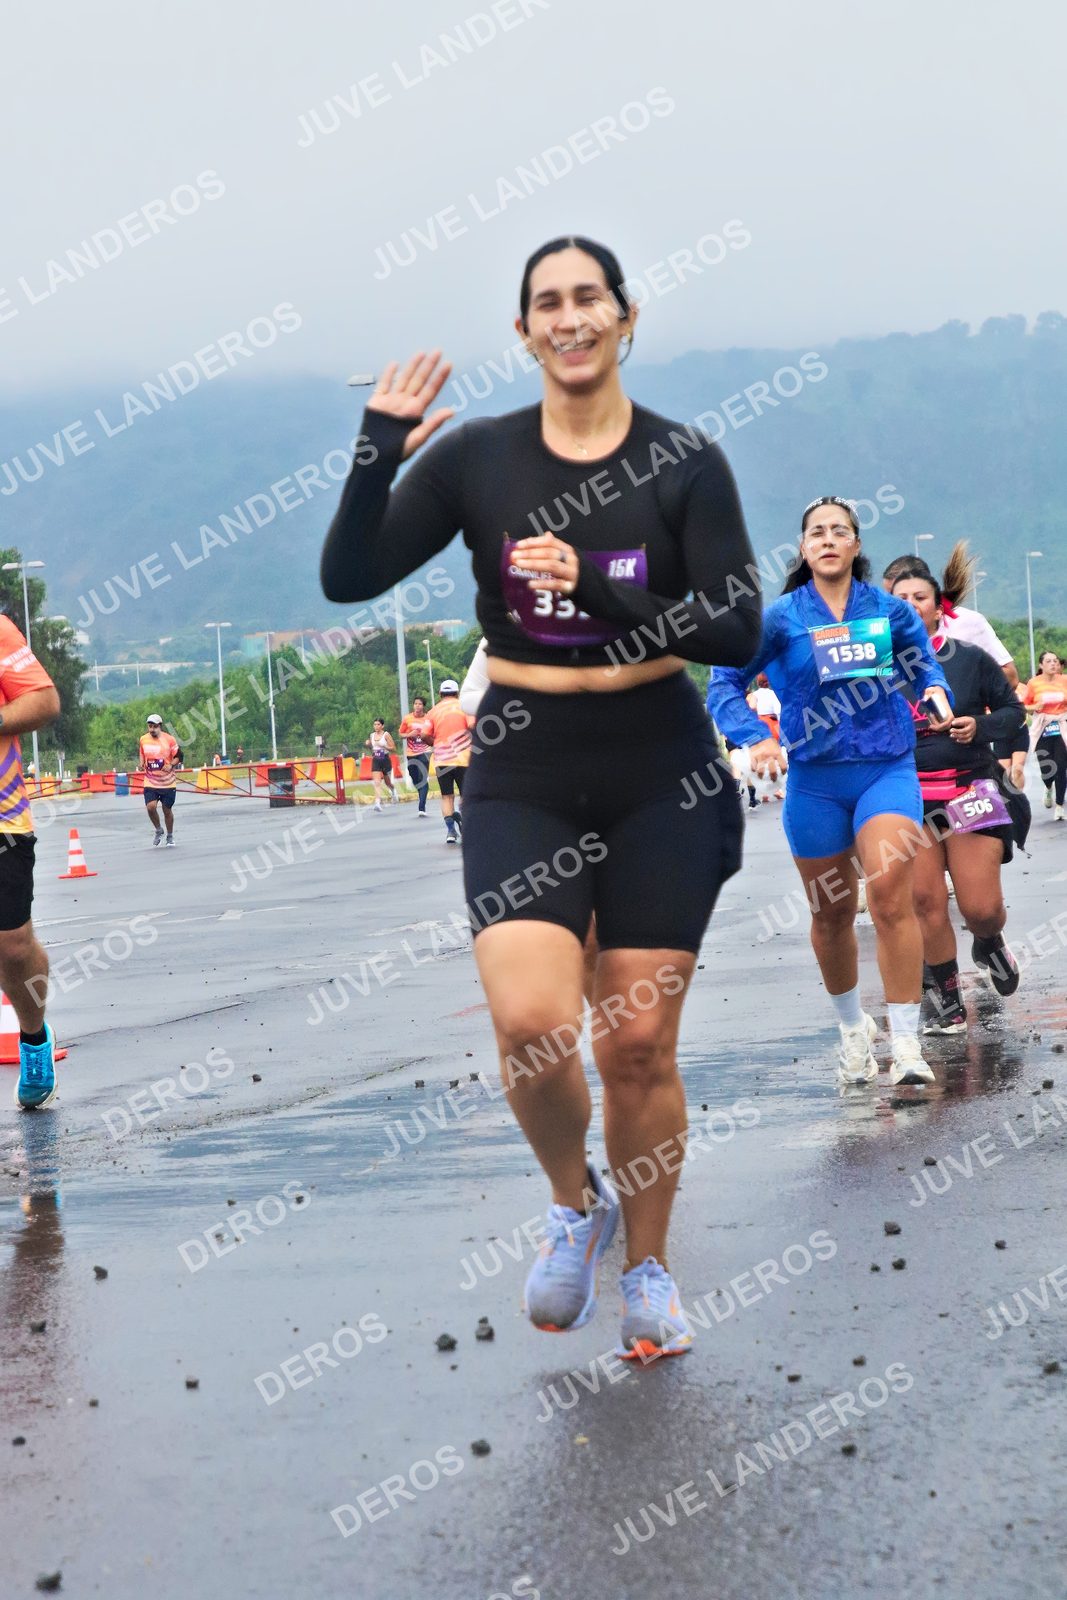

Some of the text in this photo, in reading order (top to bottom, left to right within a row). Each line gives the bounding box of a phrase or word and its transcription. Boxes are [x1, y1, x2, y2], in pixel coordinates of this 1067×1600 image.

[608, 557, 637, 578] 15K
[533, 589, 591, 620] 33
[828, 642, 877, 664] 1538
[963, 798, 994, 818] 506
